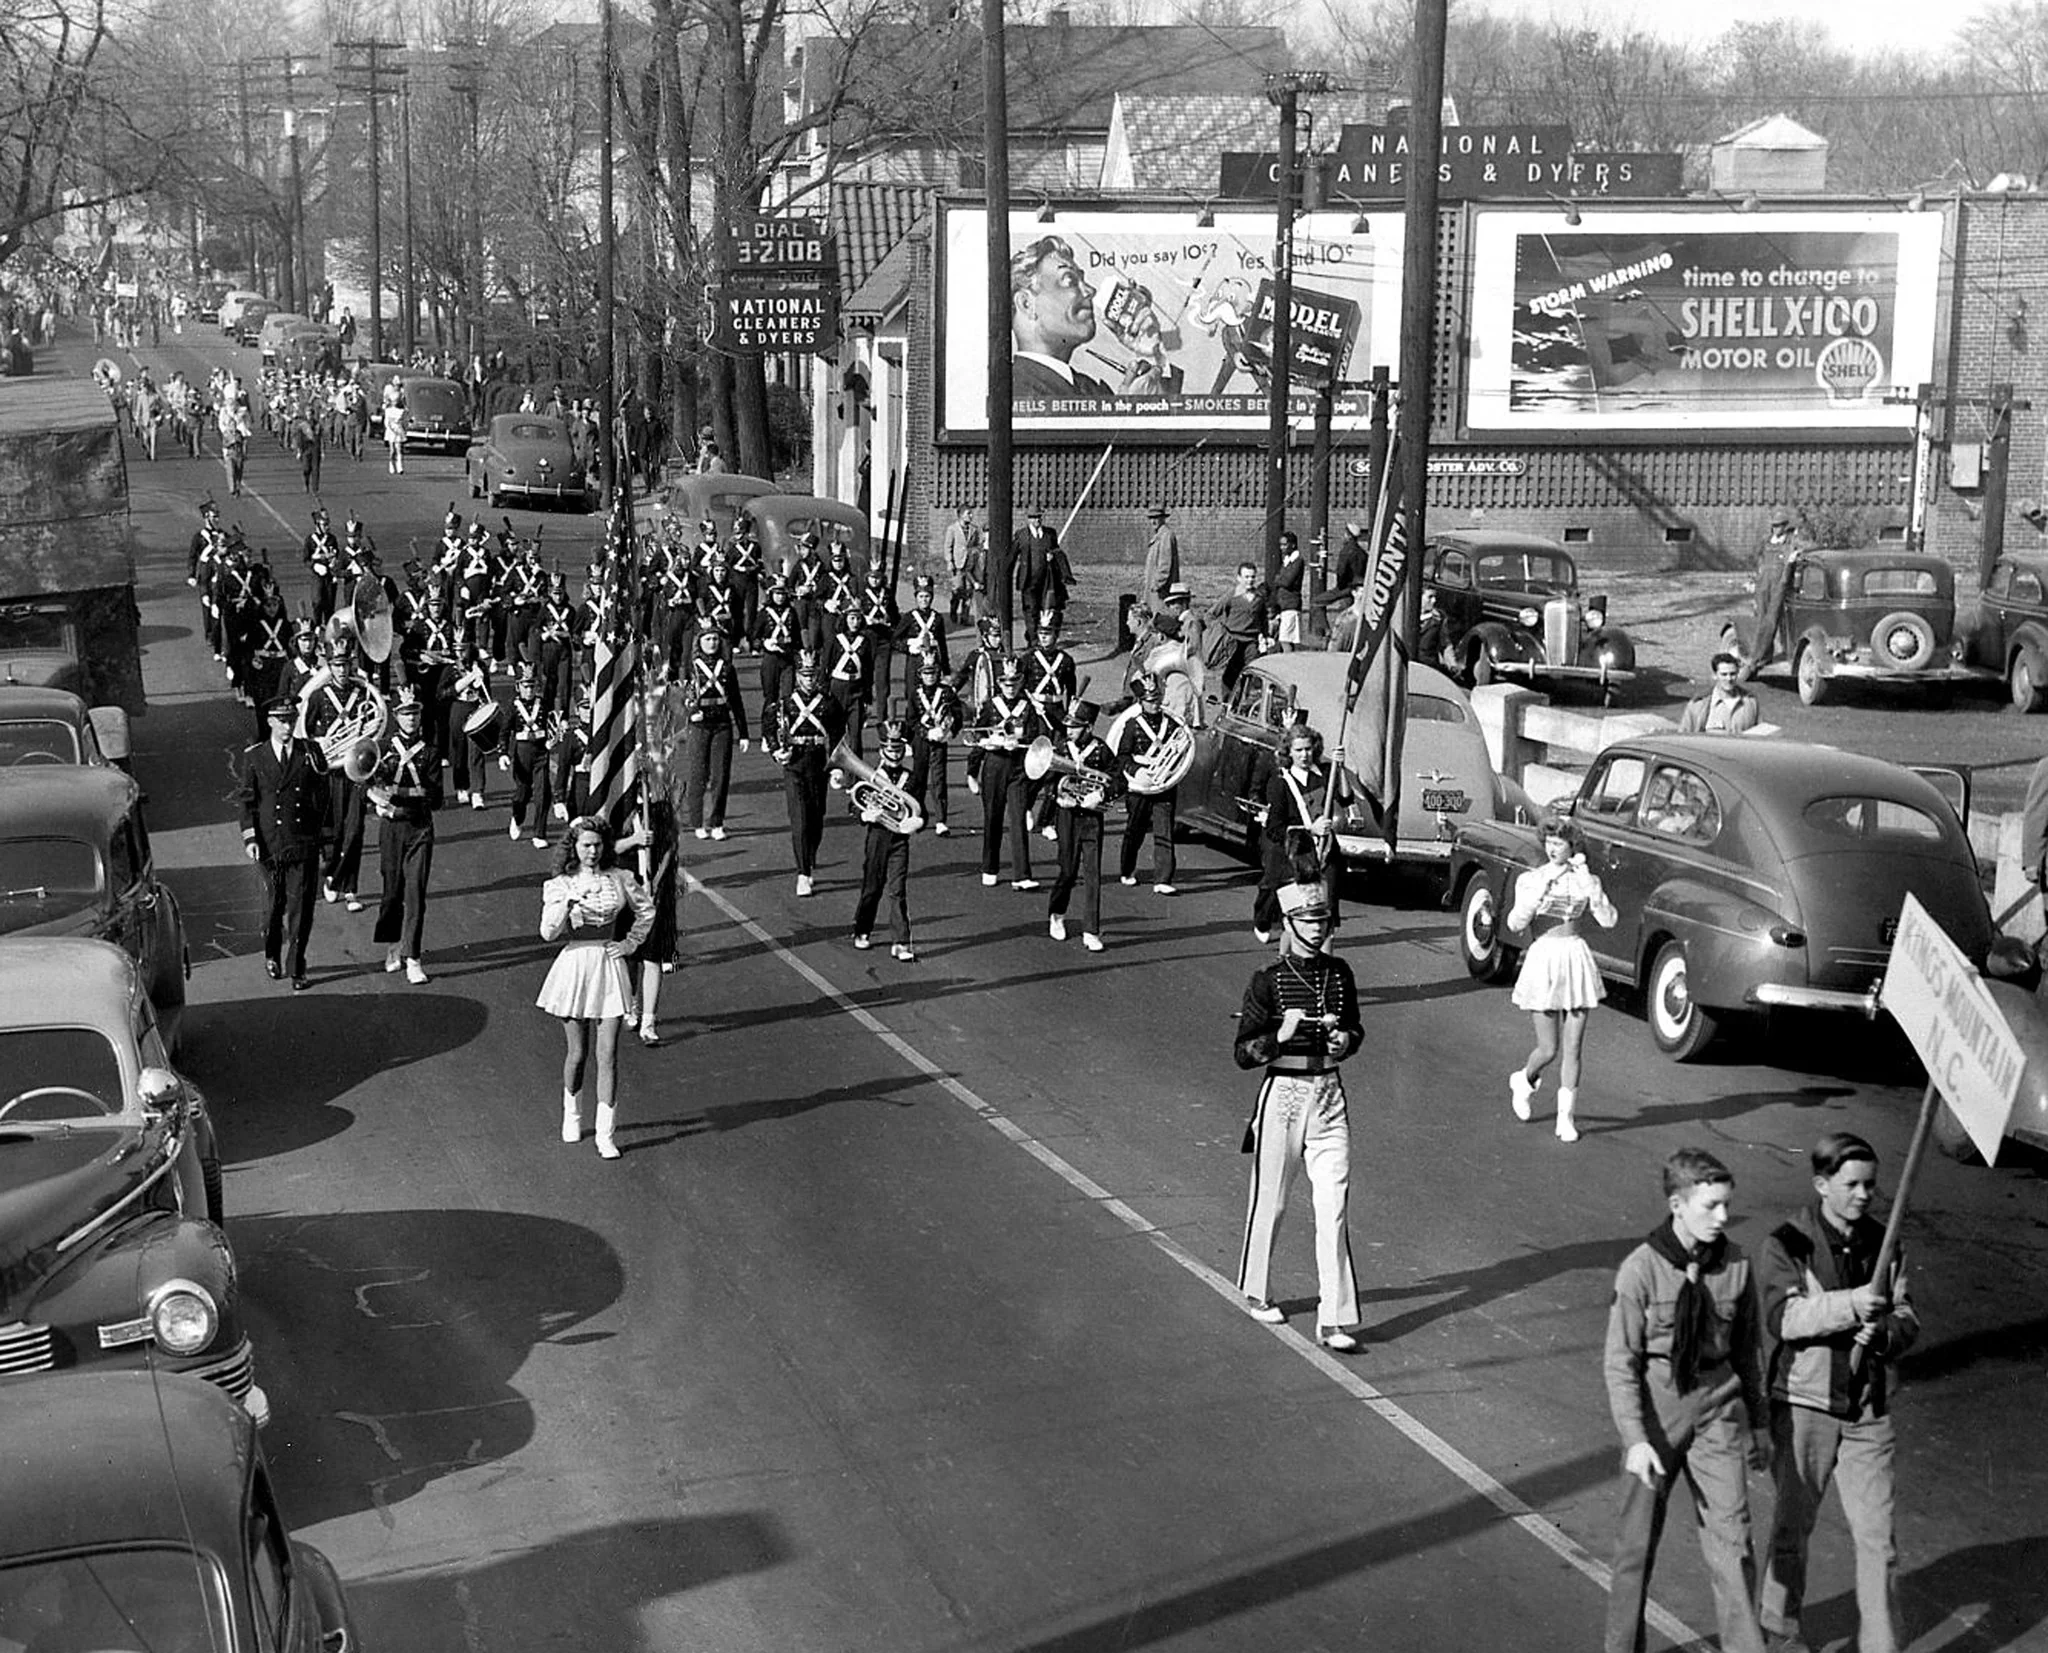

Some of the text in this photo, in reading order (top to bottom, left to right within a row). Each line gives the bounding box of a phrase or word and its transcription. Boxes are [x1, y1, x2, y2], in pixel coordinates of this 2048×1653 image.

[1371, 135, 1543, 154] NAIONAL
[1268, 163, 1452, 184] CANES
[1483, 163, 1497, 182] &
[754, 222, 805, 238] DIAL
[737, 240, 821, 262] 3-2108
[1089, 250, 1116, 268] Did
[1121, 254, 1148, 270] you
[1153, 251, 1178, 266] say
[1528, 252, 1674, 315] STORM WARNING
[1683, 264, 1880, 291] time to change to
[729, 298, 826, 314] NATIONAL
[733, 316, 821, 330] CLEANERS
[1681, 296, 1879, 338] SHELL X-100
[739, 331, 815, 344] & DYERS
[1680, 347, 1816, 370] MOTOR OIL
[1828, 363, 1873, 379] SHELL
[1051, 399, 1098, 412] BETTER
[1101, 399, 1112, 411] in
[1114, 399, 1132, 411] the
[1136, 398, 1169, 414] pouch
[1184, 398, 1241, 411] SMOKES
[1296, 399, 1307, 411] in
[1333, 399, 1357, 413] pipe
[1945, 973, 2018, 1101] MOUNTAIN
